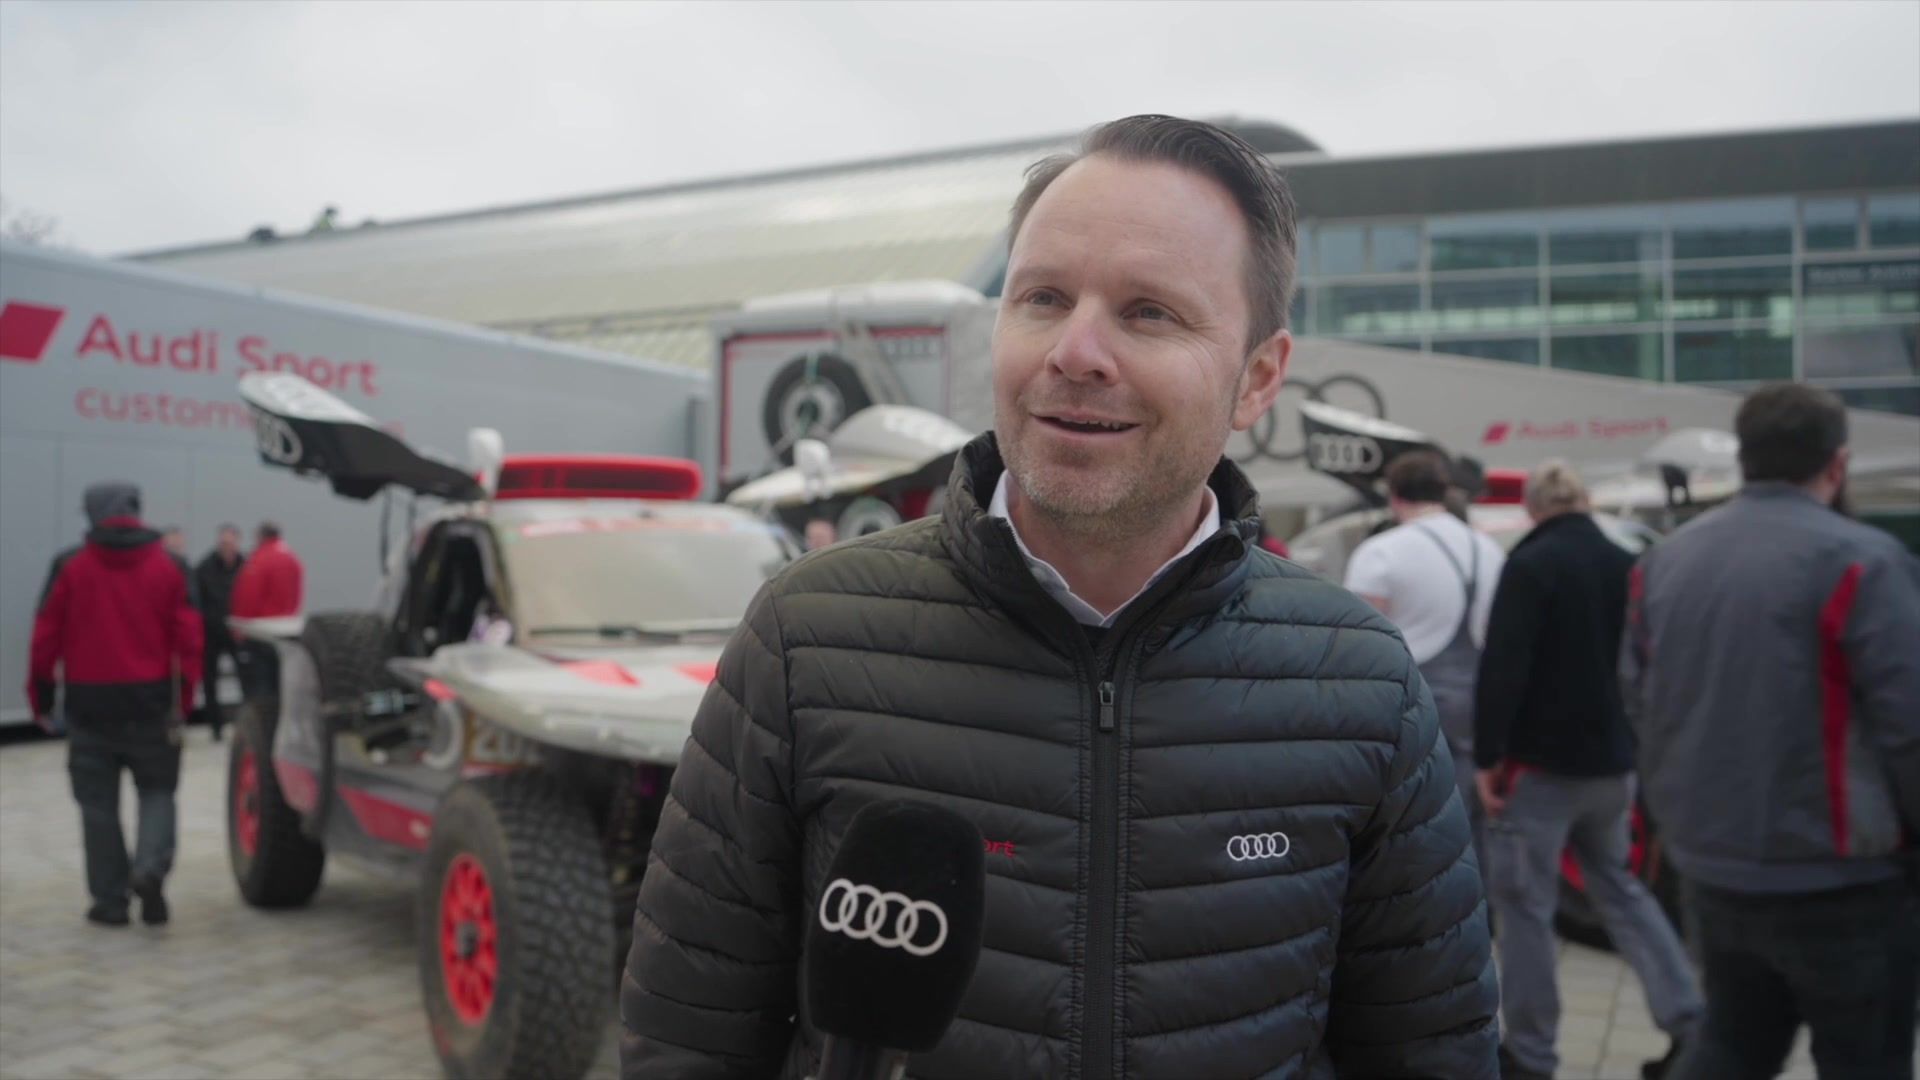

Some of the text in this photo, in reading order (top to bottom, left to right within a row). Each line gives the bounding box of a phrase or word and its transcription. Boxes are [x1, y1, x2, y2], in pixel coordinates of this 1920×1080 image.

[77, 313, 218, 372] Audi
[75, 388, 254, 429] custom
[1518, 415, 1670, 442] Audi Sport
[984, 839, 1015, 858] ort
